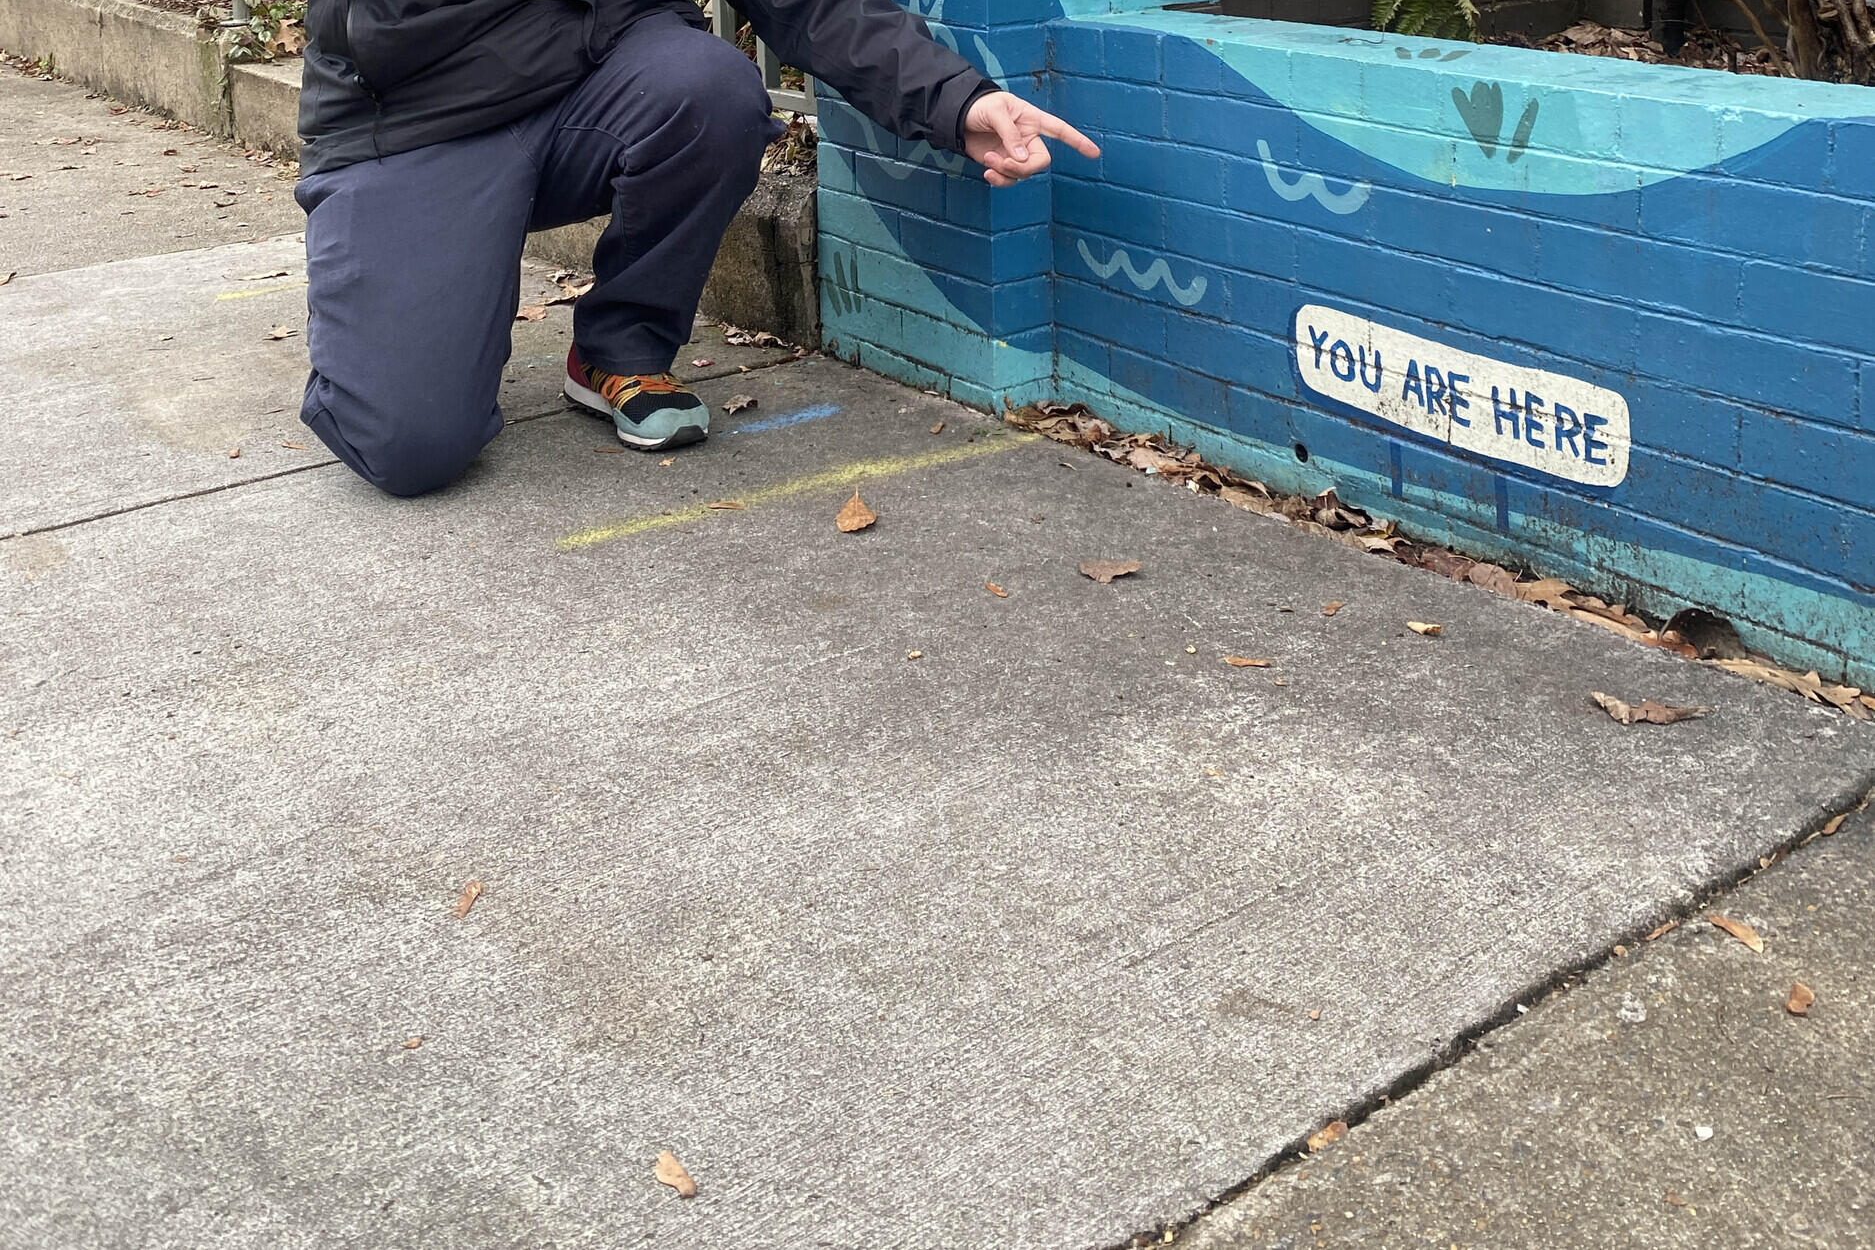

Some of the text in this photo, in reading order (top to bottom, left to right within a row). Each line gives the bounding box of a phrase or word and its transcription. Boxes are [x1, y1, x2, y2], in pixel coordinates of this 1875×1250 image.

[1308, 324, 1608, 466] YOU ARE HERE
